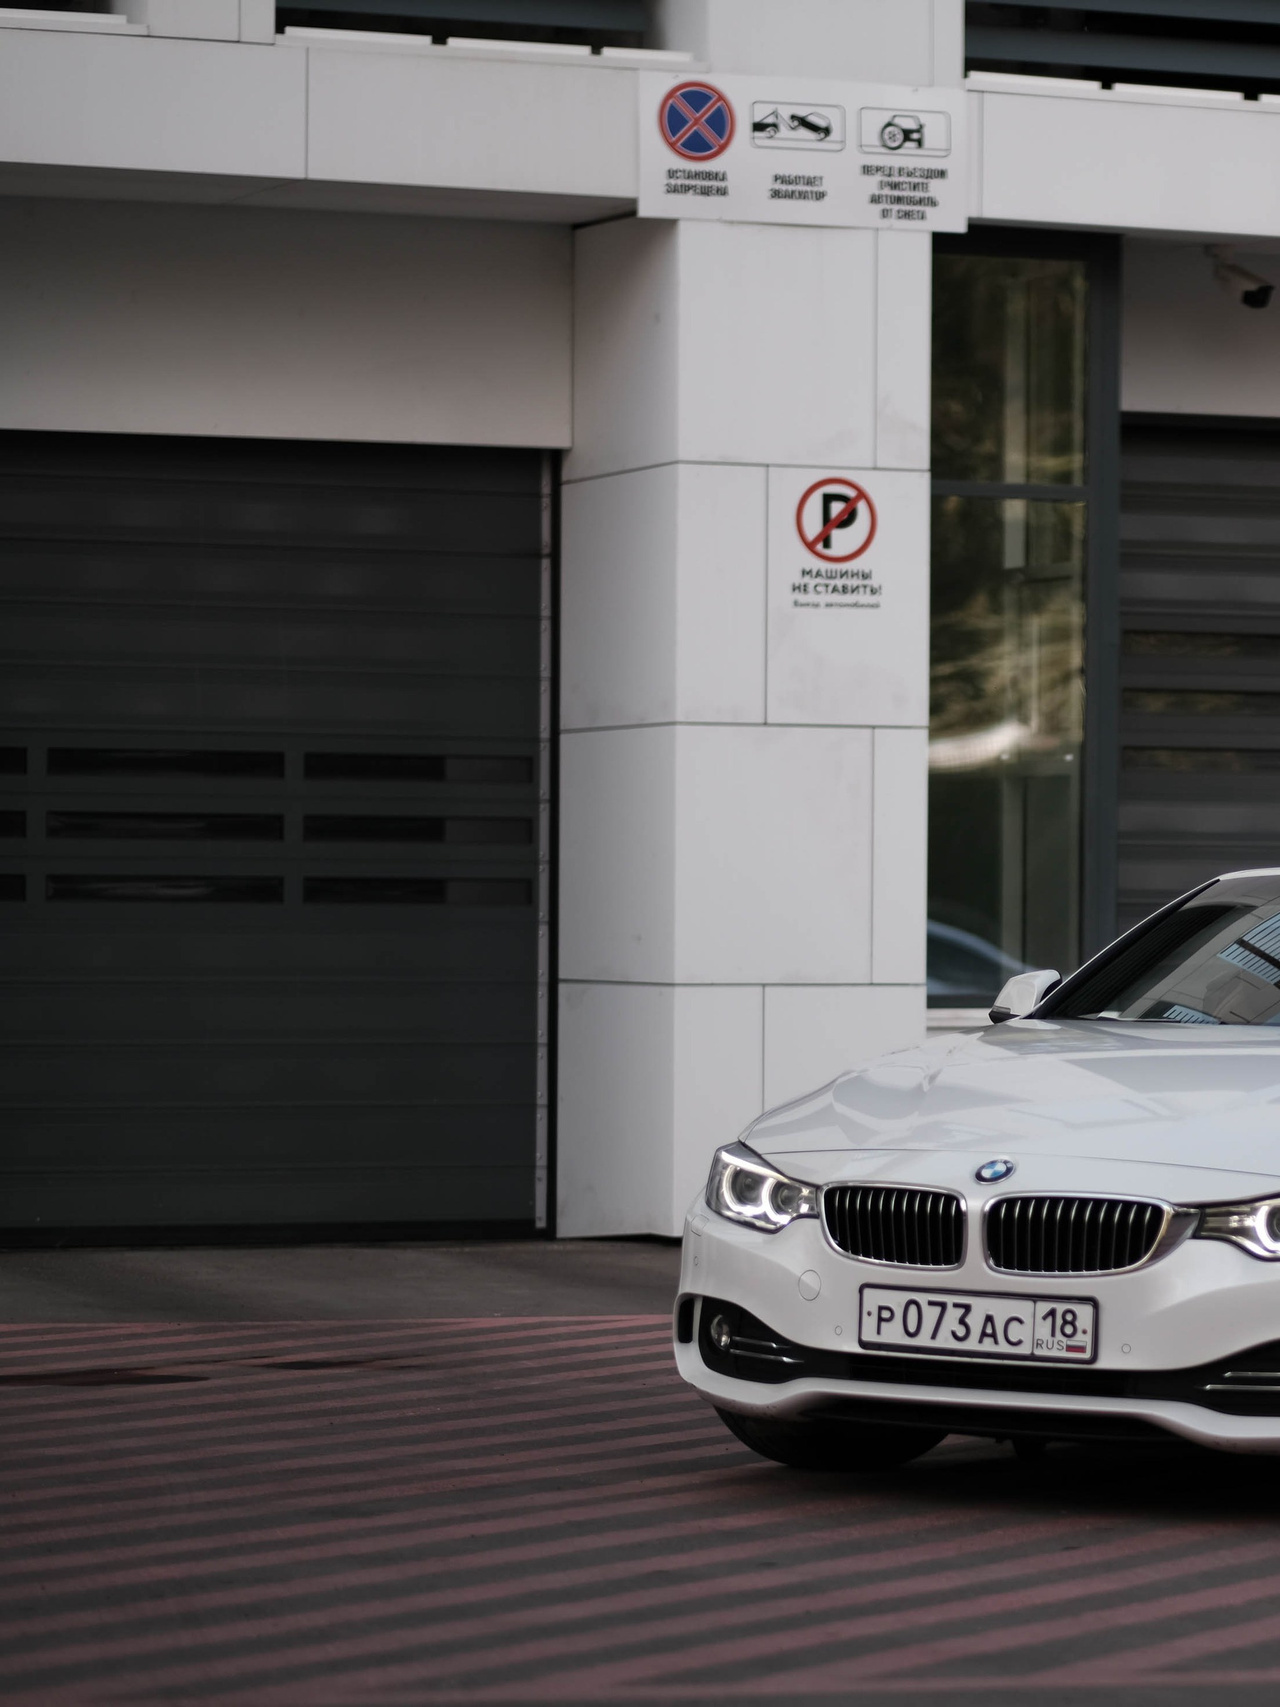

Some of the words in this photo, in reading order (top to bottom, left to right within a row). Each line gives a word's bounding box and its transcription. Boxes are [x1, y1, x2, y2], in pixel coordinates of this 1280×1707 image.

[666, 168, 728, 182] ОСТАНОВКА
[862, 164, 895, 177] ПЕРЕД
[898, 166, 948, 180] ВЪЕЗДОМ
[773, 173, 824, 187] РАБОТАЕТ
[878, 180, 930, 193] ОЧИСТИТЕ
[665, 182, 729, 197] ЗАПРЕЩЕНА
[769, 188, 827, 201] ЭВАКУАТОР
[869, 193, 939, 207] АВТОМОБИЛЬ
[880, 207, 893, 219] ОТ
[896, 209, 927, 221] СНЕГА
[801, 567, 872, 580] МАШИНЫ
[791, 582, 810, 594] НЕ
[813, 583, 883, 596] СТАВИТЬ!
[1041, 1307, 1078, 1339] 18
[1035, 1338, 1065, 1351] RUS
